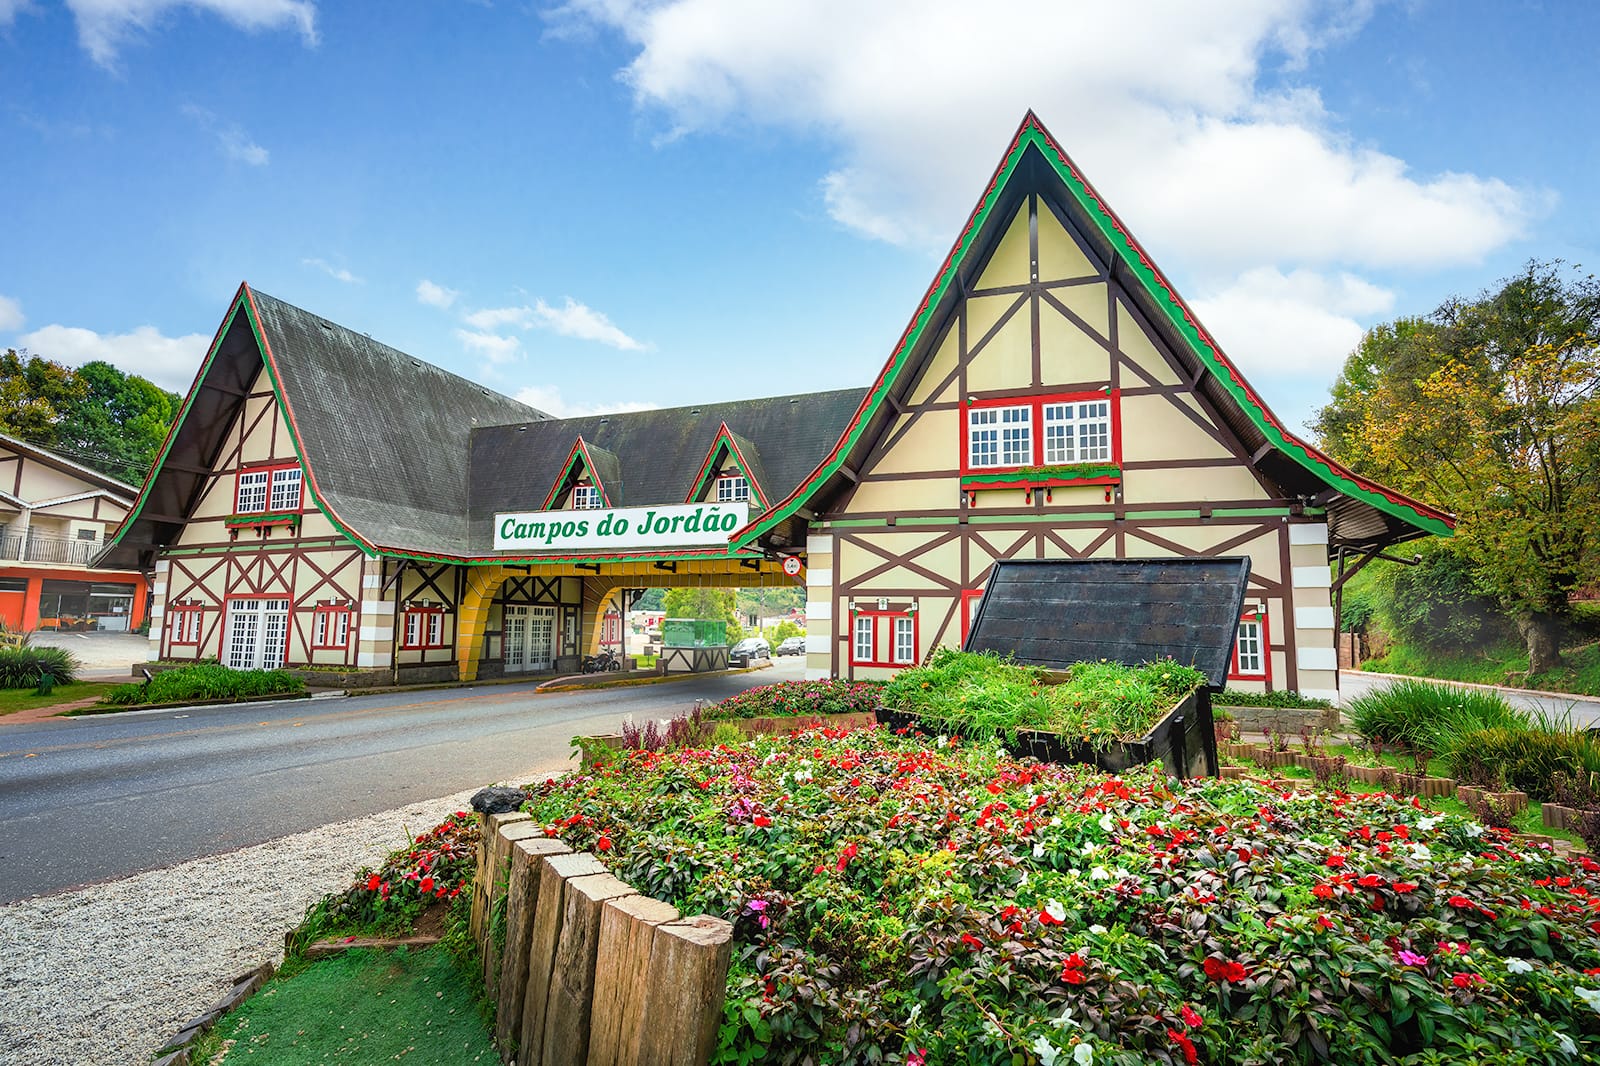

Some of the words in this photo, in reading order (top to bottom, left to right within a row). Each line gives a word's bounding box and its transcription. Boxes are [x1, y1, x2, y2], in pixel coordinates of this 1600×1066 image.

[500, 518, 589, 544] Campos
[596, 513, 629, 536] do
[637, 507, 738, 535] Jordão
